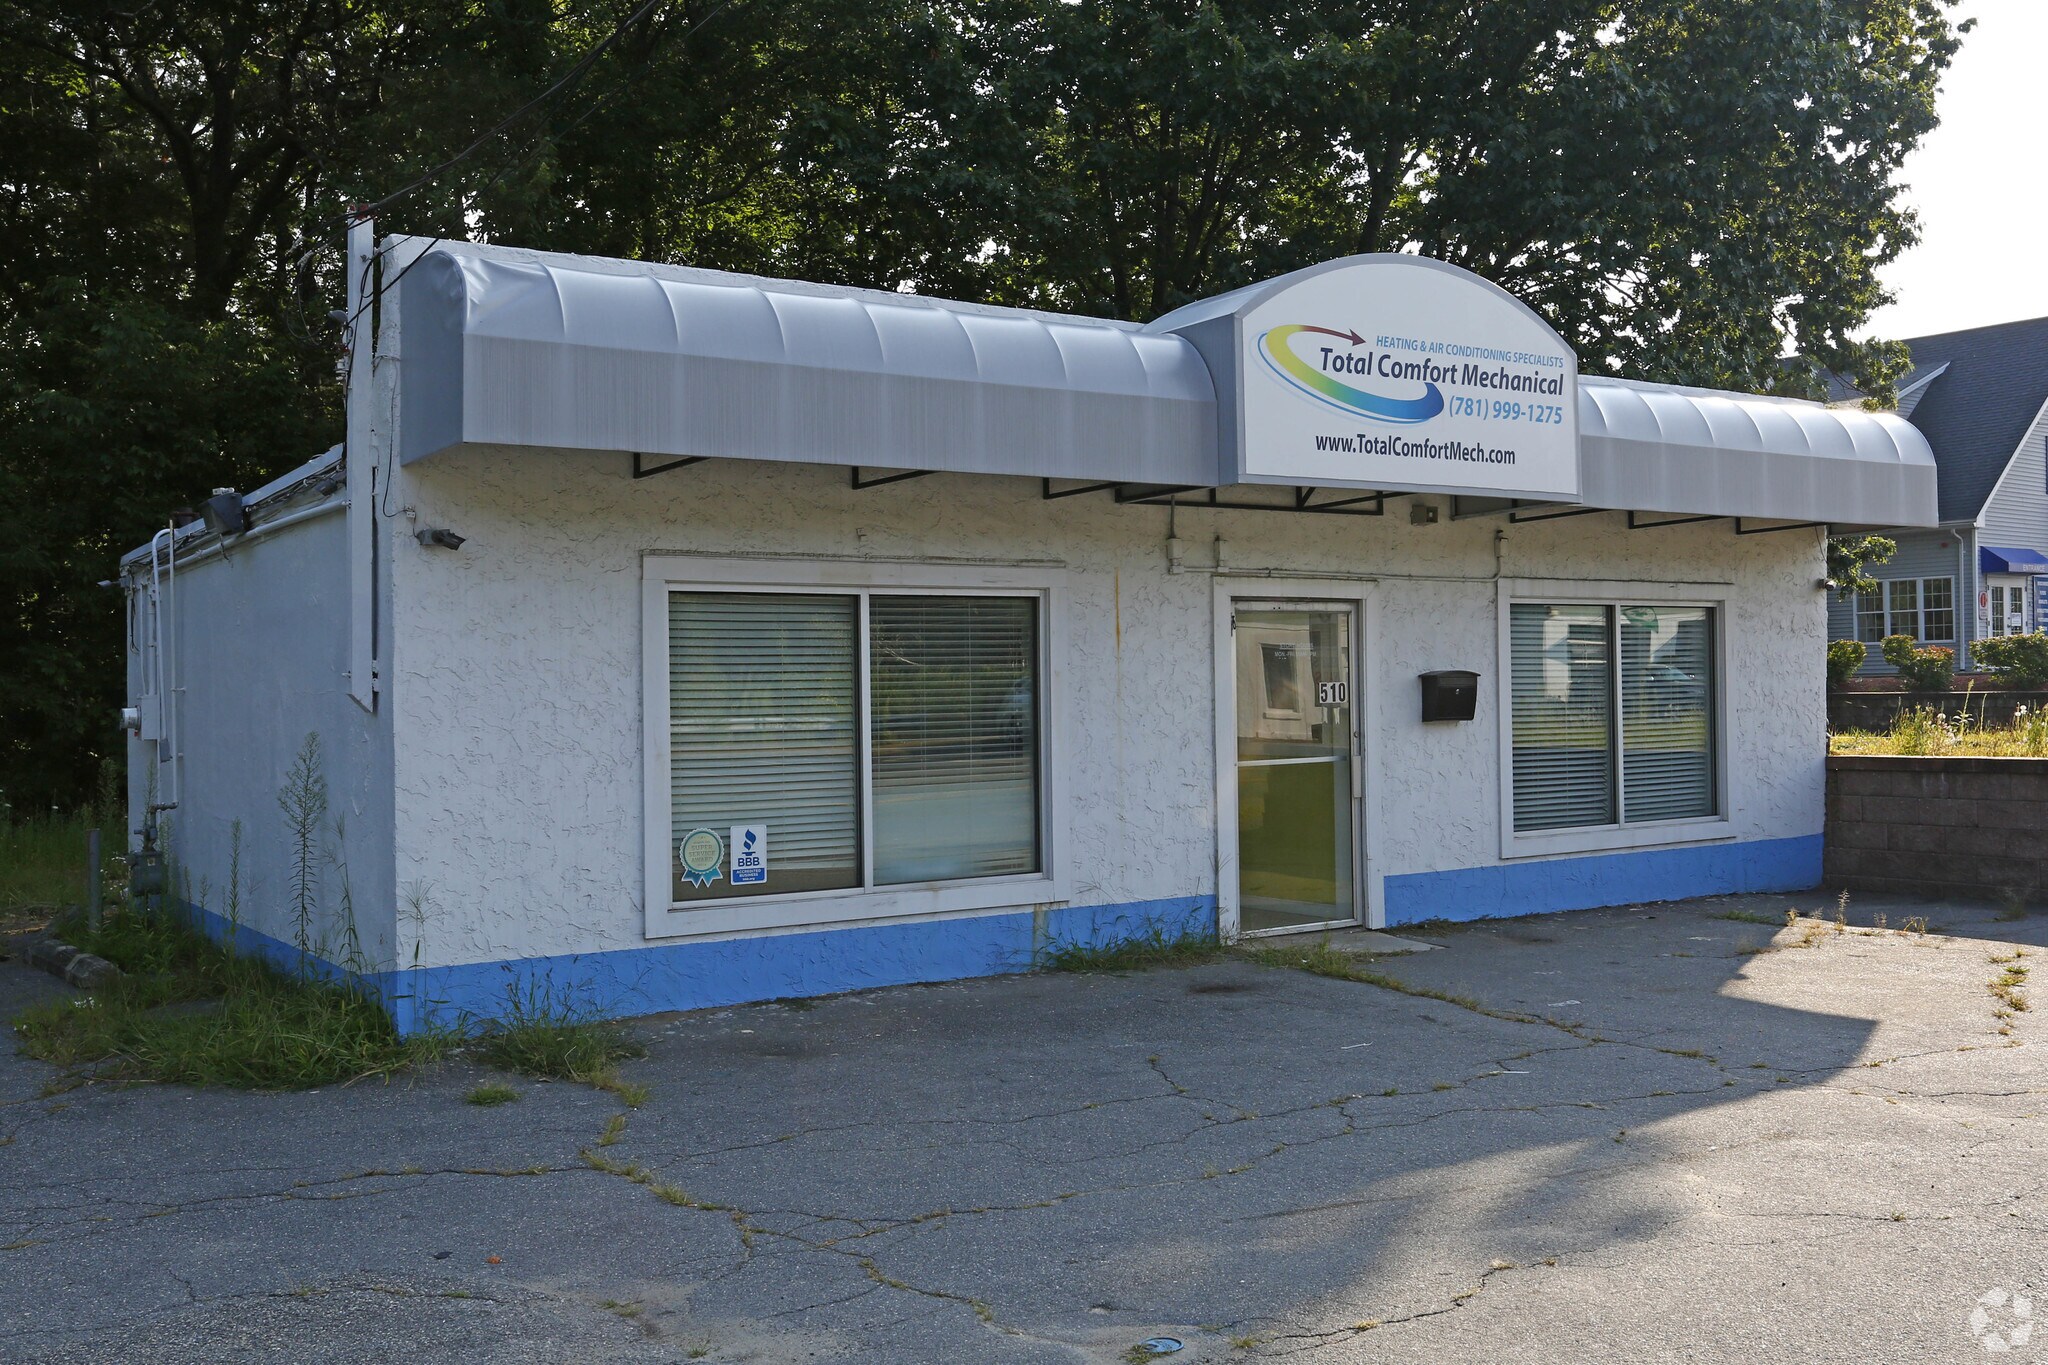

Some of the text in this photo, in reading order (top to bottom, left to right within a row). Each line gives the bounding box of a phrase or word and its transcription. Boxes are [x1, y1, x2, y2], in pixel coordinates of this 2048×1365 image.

[1376, 335, 1564, 368] HEATING & AIR CONDITIONING SPECIALISTS
[1320, 347, 1564, 395] Total Comfort Mechanical
[1449, 395, 1563, 424] (781) 999-1275
[1315, 433, 1516, 464] www.TotalComfortMech.com
[2023, 564, 2046, 572] ENTRANCE
[1320, 683, 1346, 702] 510
[737, 856, 760, 867] BBB
